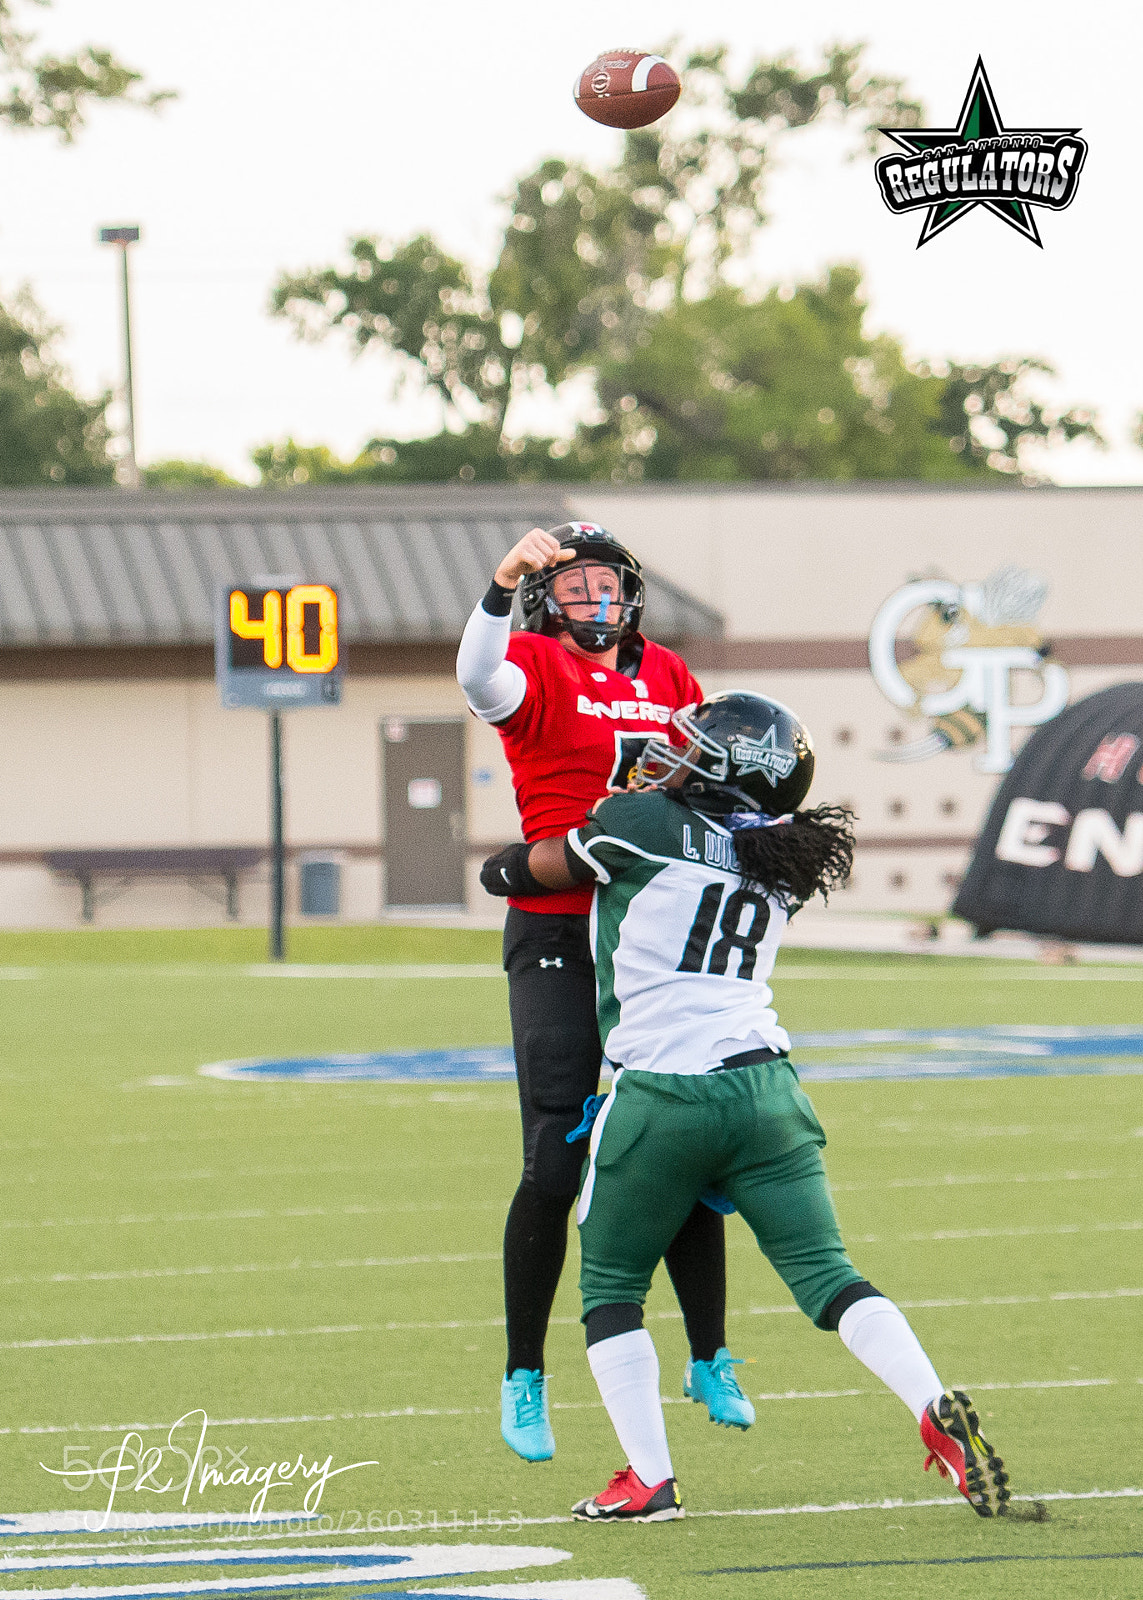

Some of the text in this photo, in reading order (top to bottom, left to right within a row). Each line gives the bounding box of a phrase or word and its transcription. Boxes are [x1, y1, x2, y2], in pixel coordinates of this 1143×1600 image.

[229, 584, 338, 674] 40
[577, 694, 675, 724] ENERG
[675, 882, 771, 980] 18
